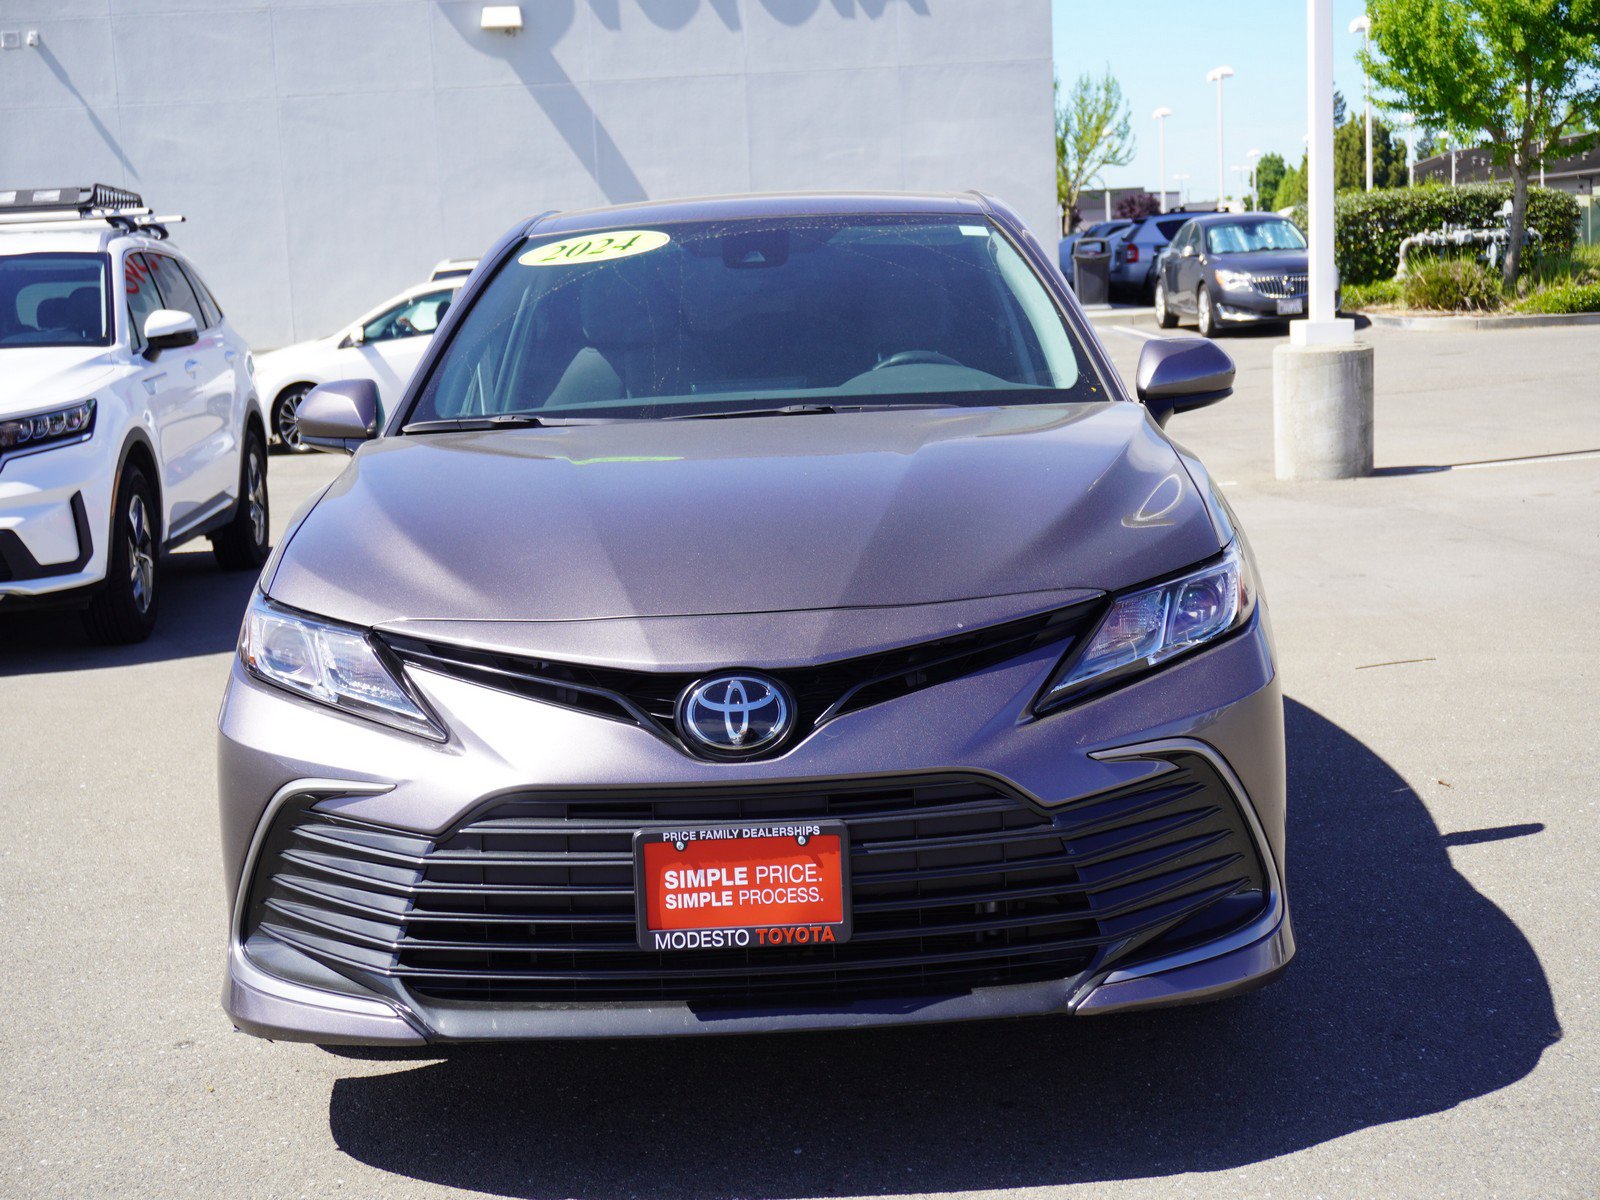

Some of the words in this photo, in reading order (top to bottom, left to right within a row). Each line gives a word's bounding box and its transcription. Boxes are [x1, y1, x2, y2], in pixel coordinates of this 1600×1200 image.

[538, 234, 642, 262] 2024
[662, 831, 697, 842] PRICE
[700, 828, 739, 840] FAMILY
[742, 825, 820, 838] DEALERSHIPS
[664, 867, 748, 890] SIMPLE
[755, 863, 823, 885] PRICE.
[665, 890, 733, 910] SIMPLE
[739, 887, 824, 906] PROCESS.
[655, 928, 750, 950] MODESTO
[755, 925, 836, 945] TOYOTA
